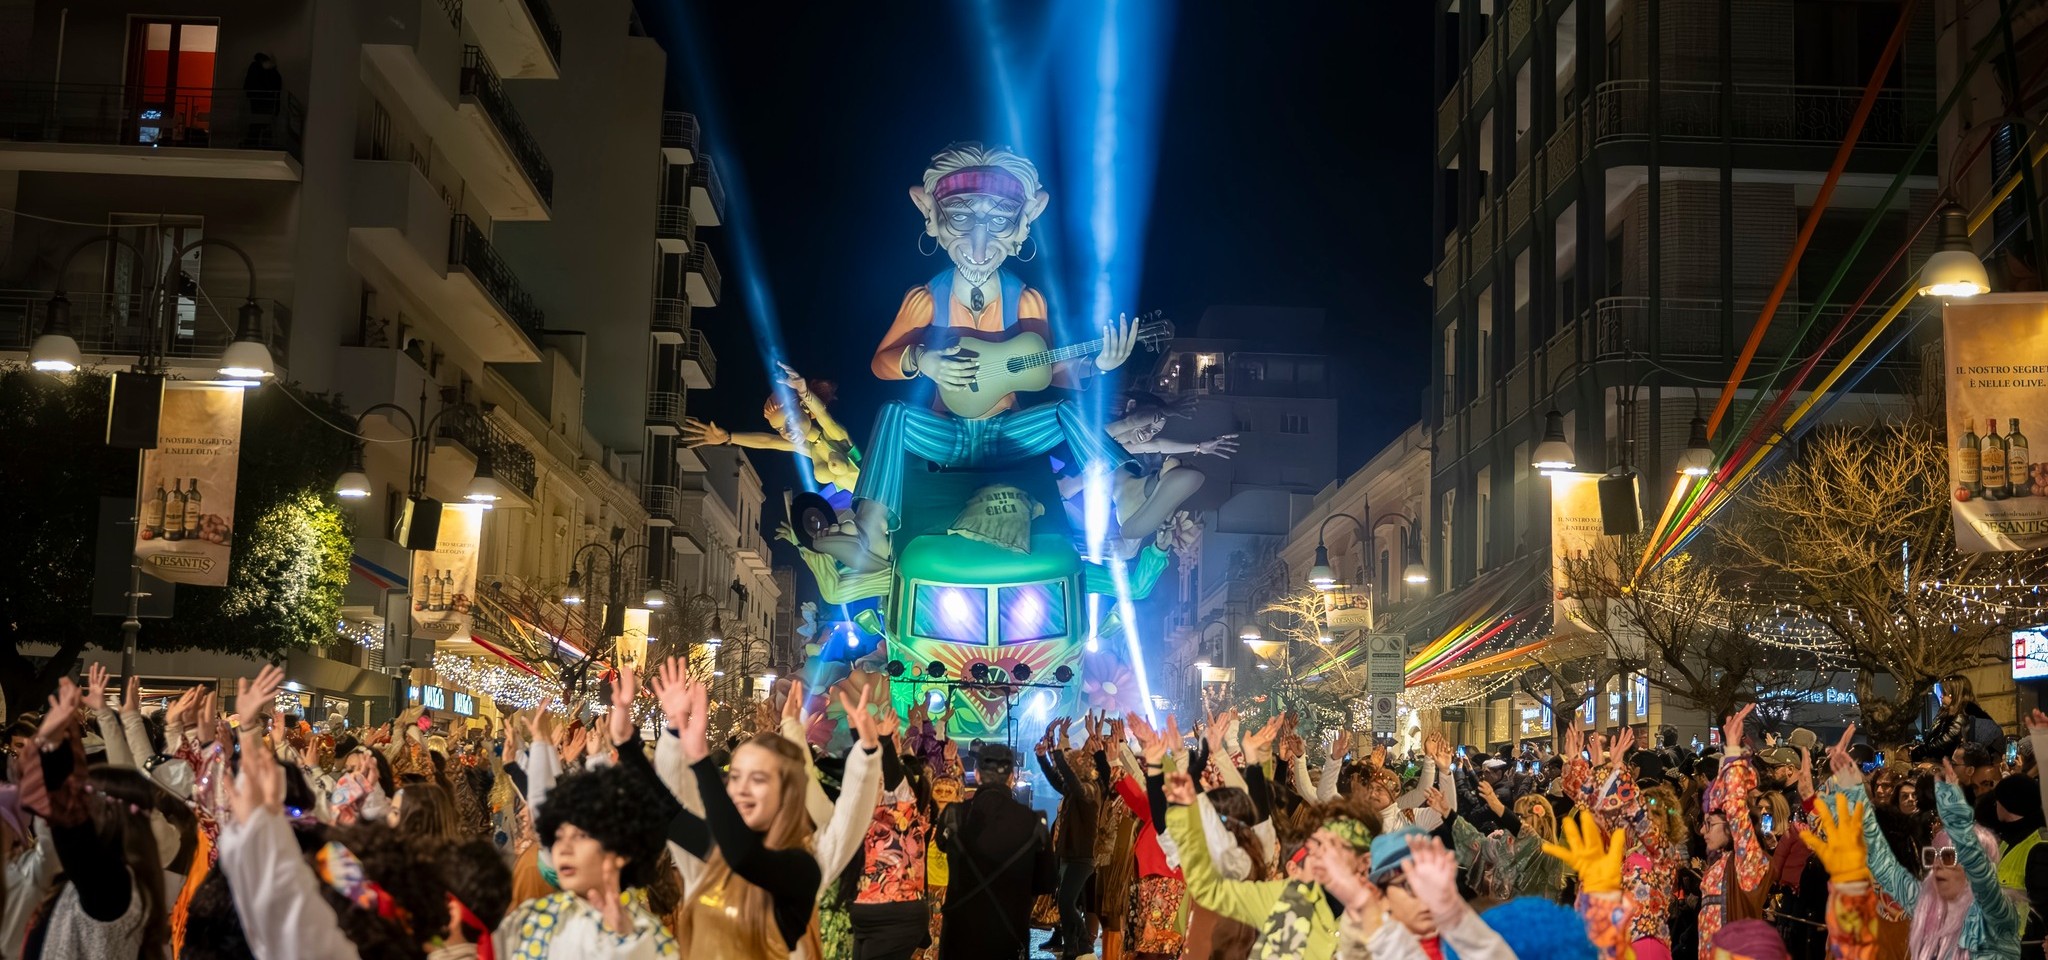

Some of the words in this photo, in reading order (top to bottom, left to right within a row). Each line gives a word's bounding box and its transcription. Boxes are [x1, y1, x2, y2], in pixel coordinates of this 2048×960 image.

[1968, 366, 2010, 374] NOSTRO
[1978, 379, 2011, 388] NELLE
[2013, 379, 2046, 388] OLIVE.
[154, 556, 211, 571] DESANTIS
